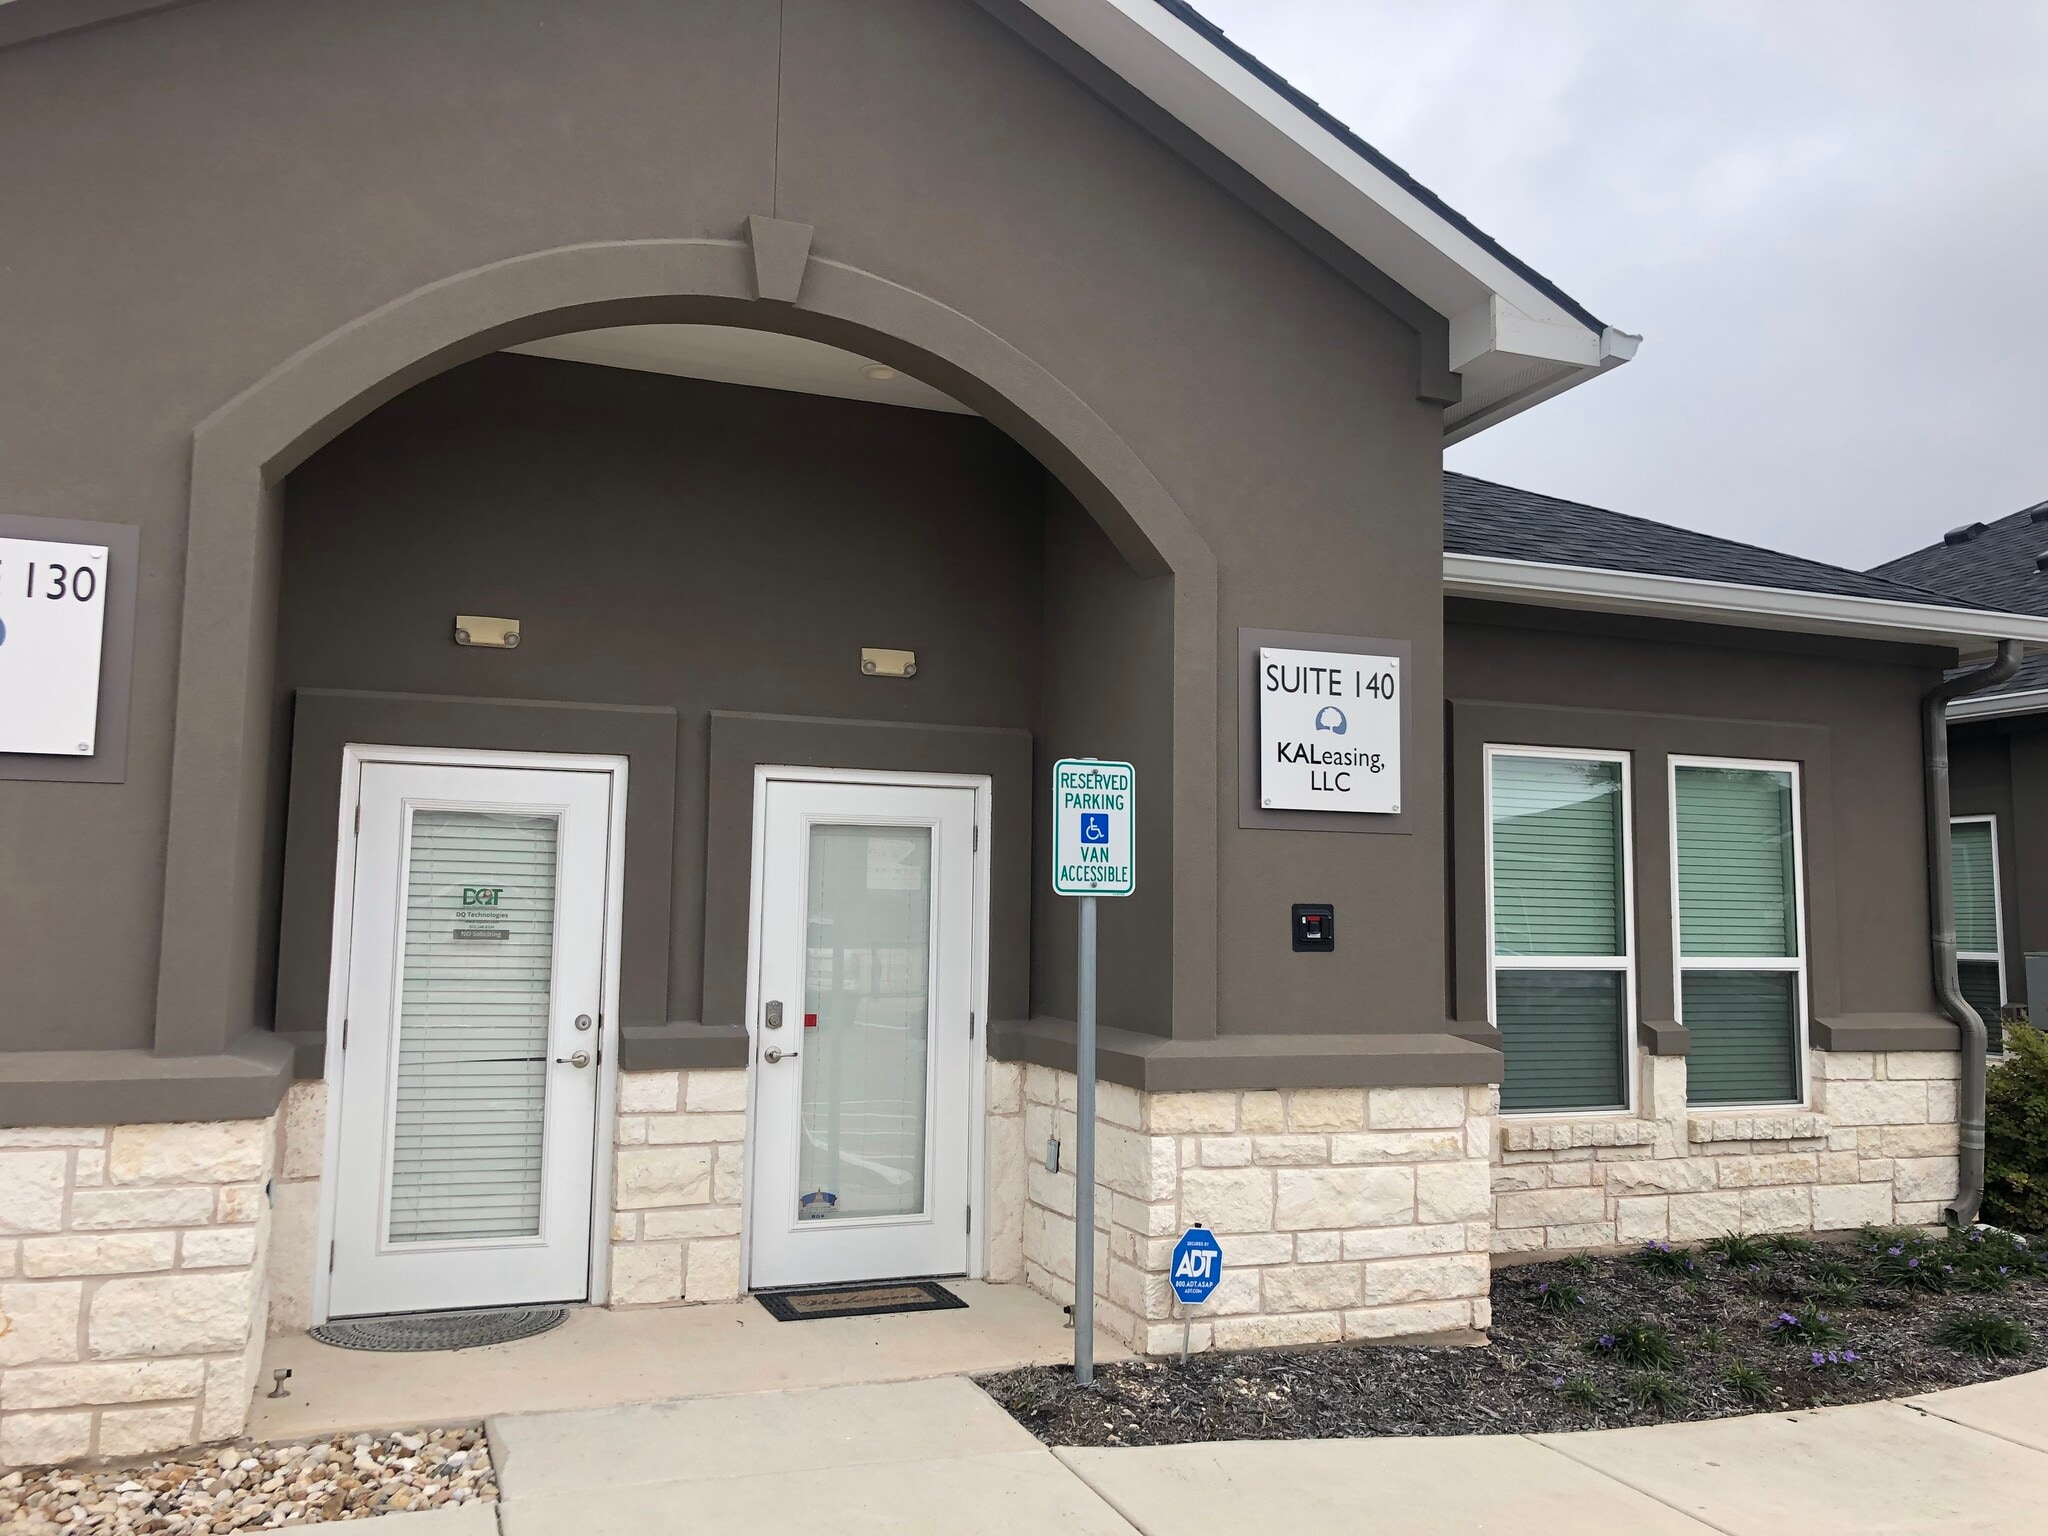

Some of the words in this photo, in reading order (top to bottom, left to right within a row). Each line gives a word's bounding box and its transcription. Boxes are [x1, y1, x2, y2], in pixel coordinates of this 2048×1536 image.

[26, 561, 97, 603] 130
[1266, 663, 1343, 697] SUITE
[1356, 670, 1395, 700] 140
[1277, 741, 1385, 774] KALeasing,
[1060, 772, 1128, 791] RESERVED
[1310, 770, 1351, 792] LLC
[1065, 792, 1125, 811] PARKING
[1080, 846, 1109, 863] VAN
[1060, 865, 1128, 883] ACCESSIBLE
[455, 911, 466, 919] DQ
[467, 911, 509, 919] Technologies
[1174, 1249, 1218, 1279] ADT
